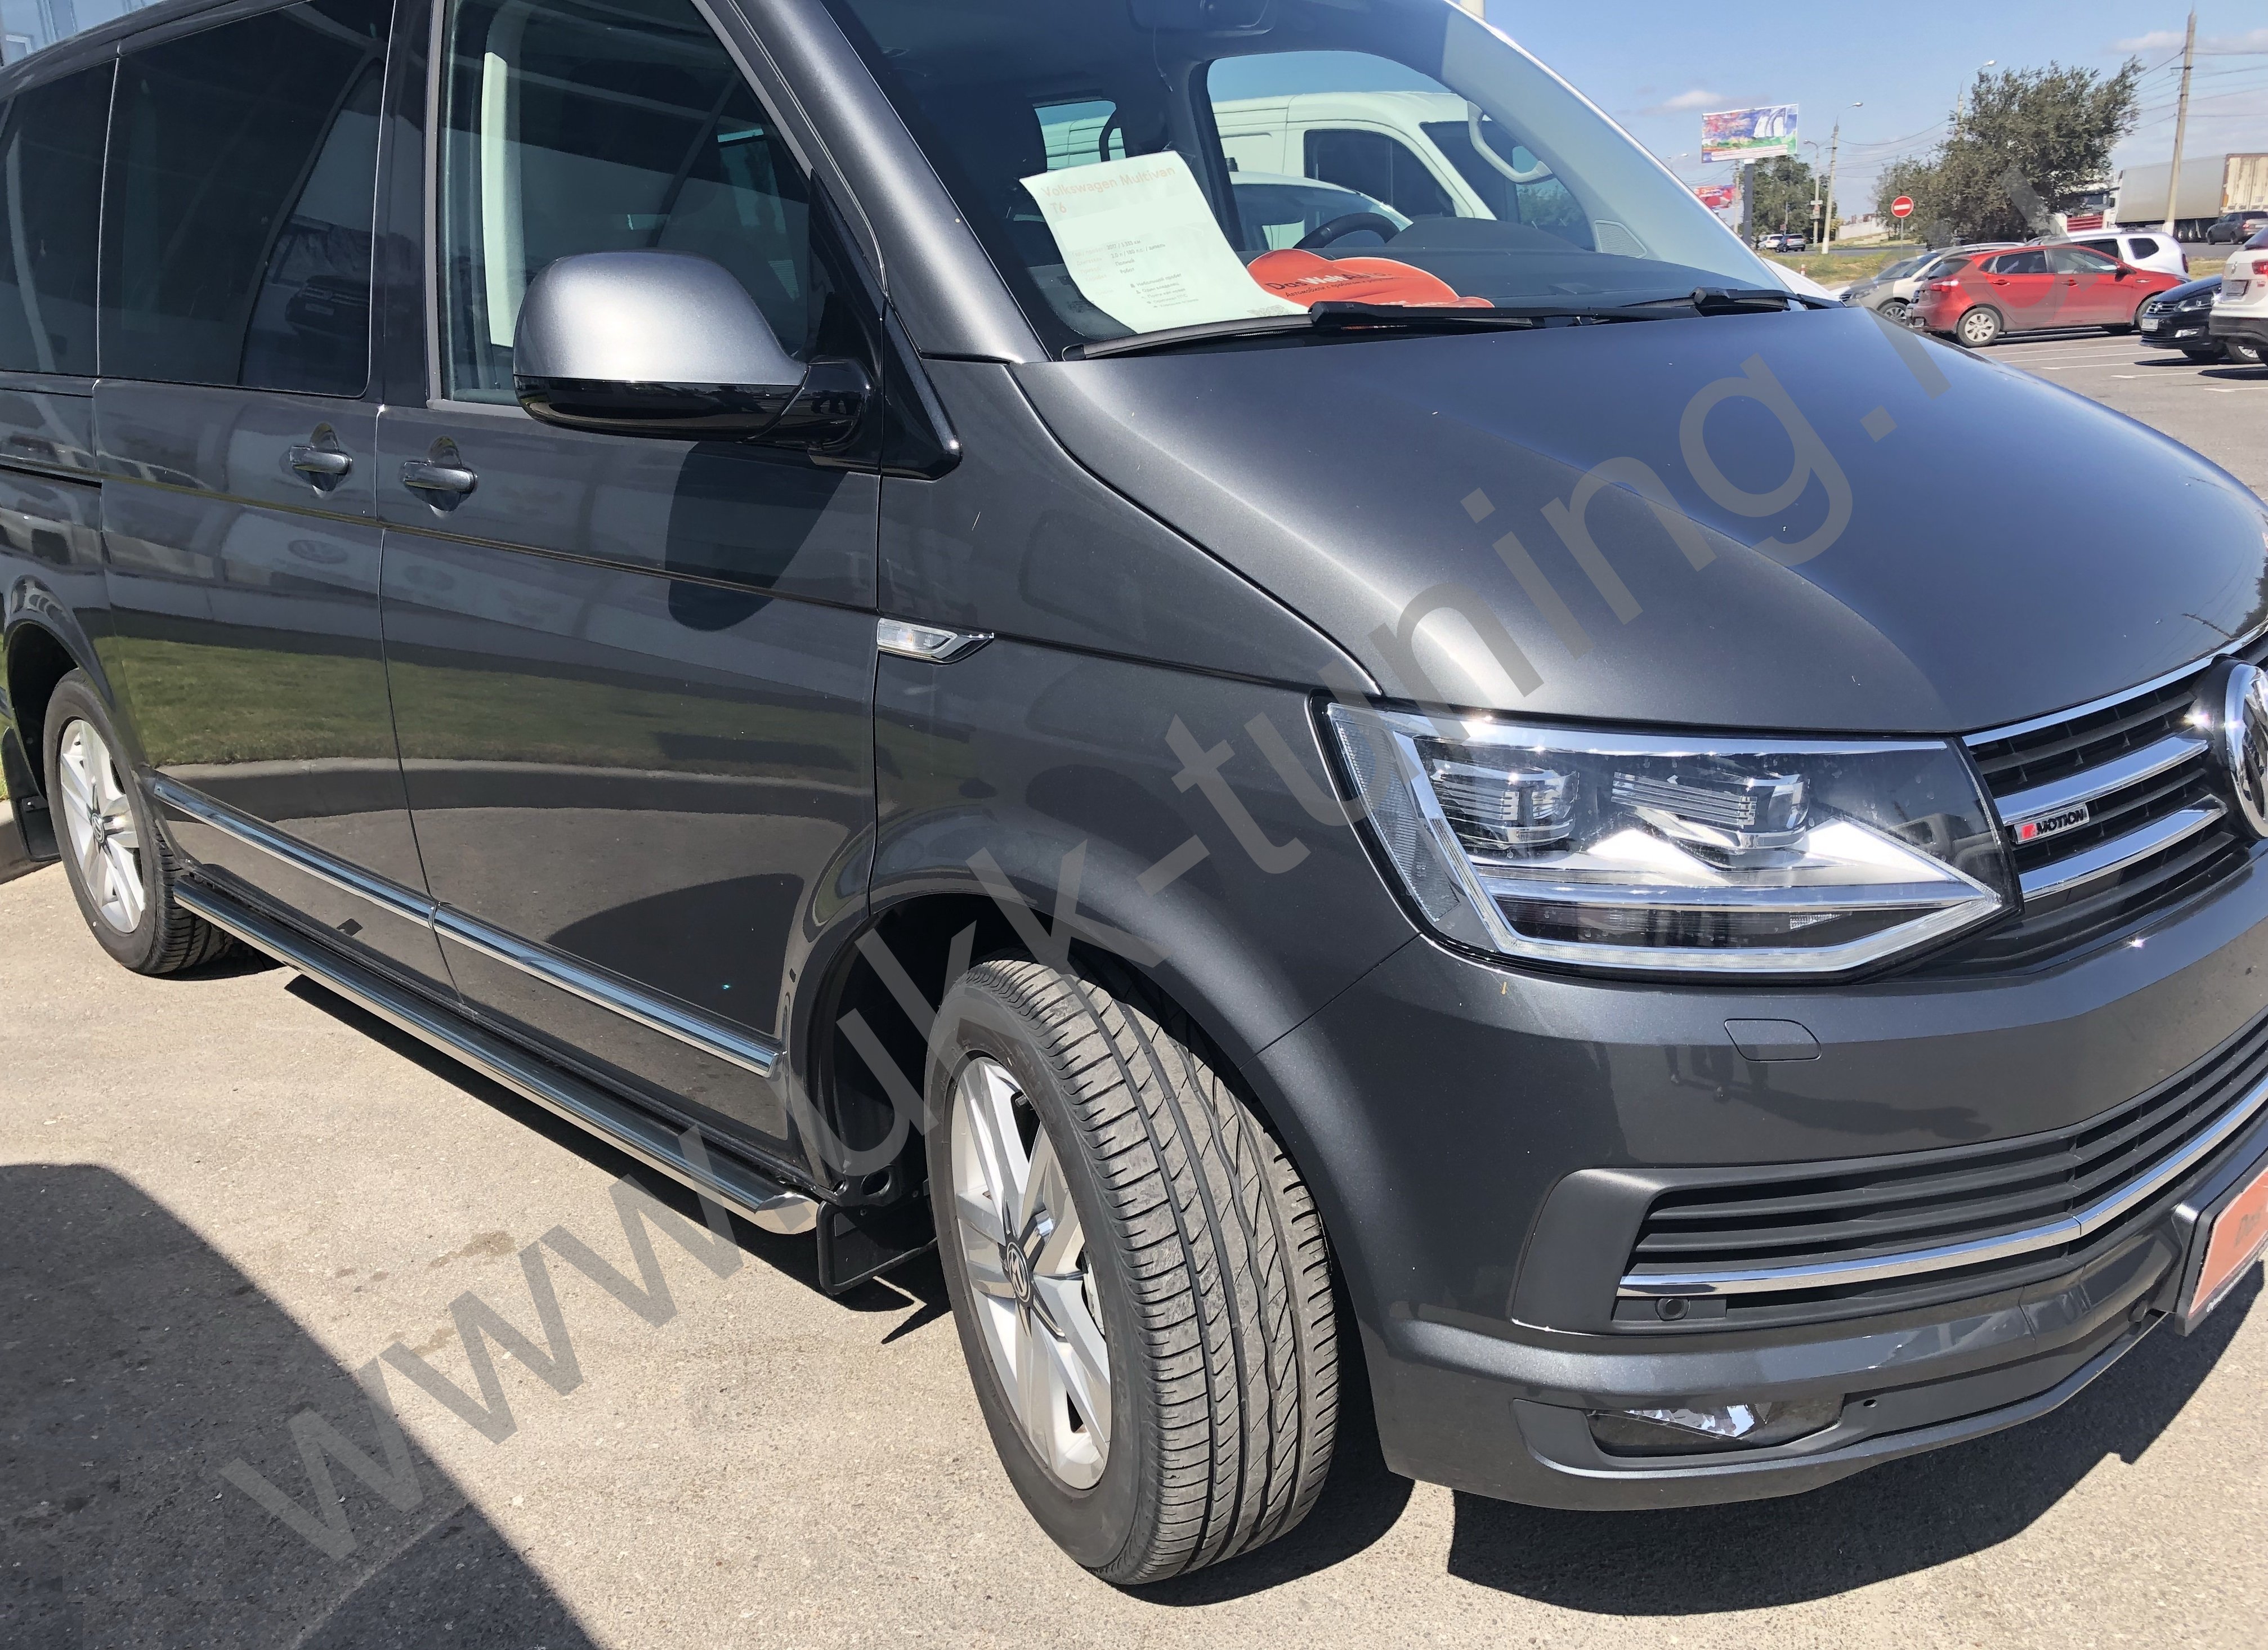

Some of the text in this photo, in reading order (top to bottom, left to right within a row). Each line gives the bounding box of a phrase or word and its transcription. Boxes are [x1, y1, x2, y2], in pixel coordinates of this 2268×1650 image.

[1041, 167, 1175, 197] Volkswagen Multivan
[1050, 202, 1067, 215] T6
